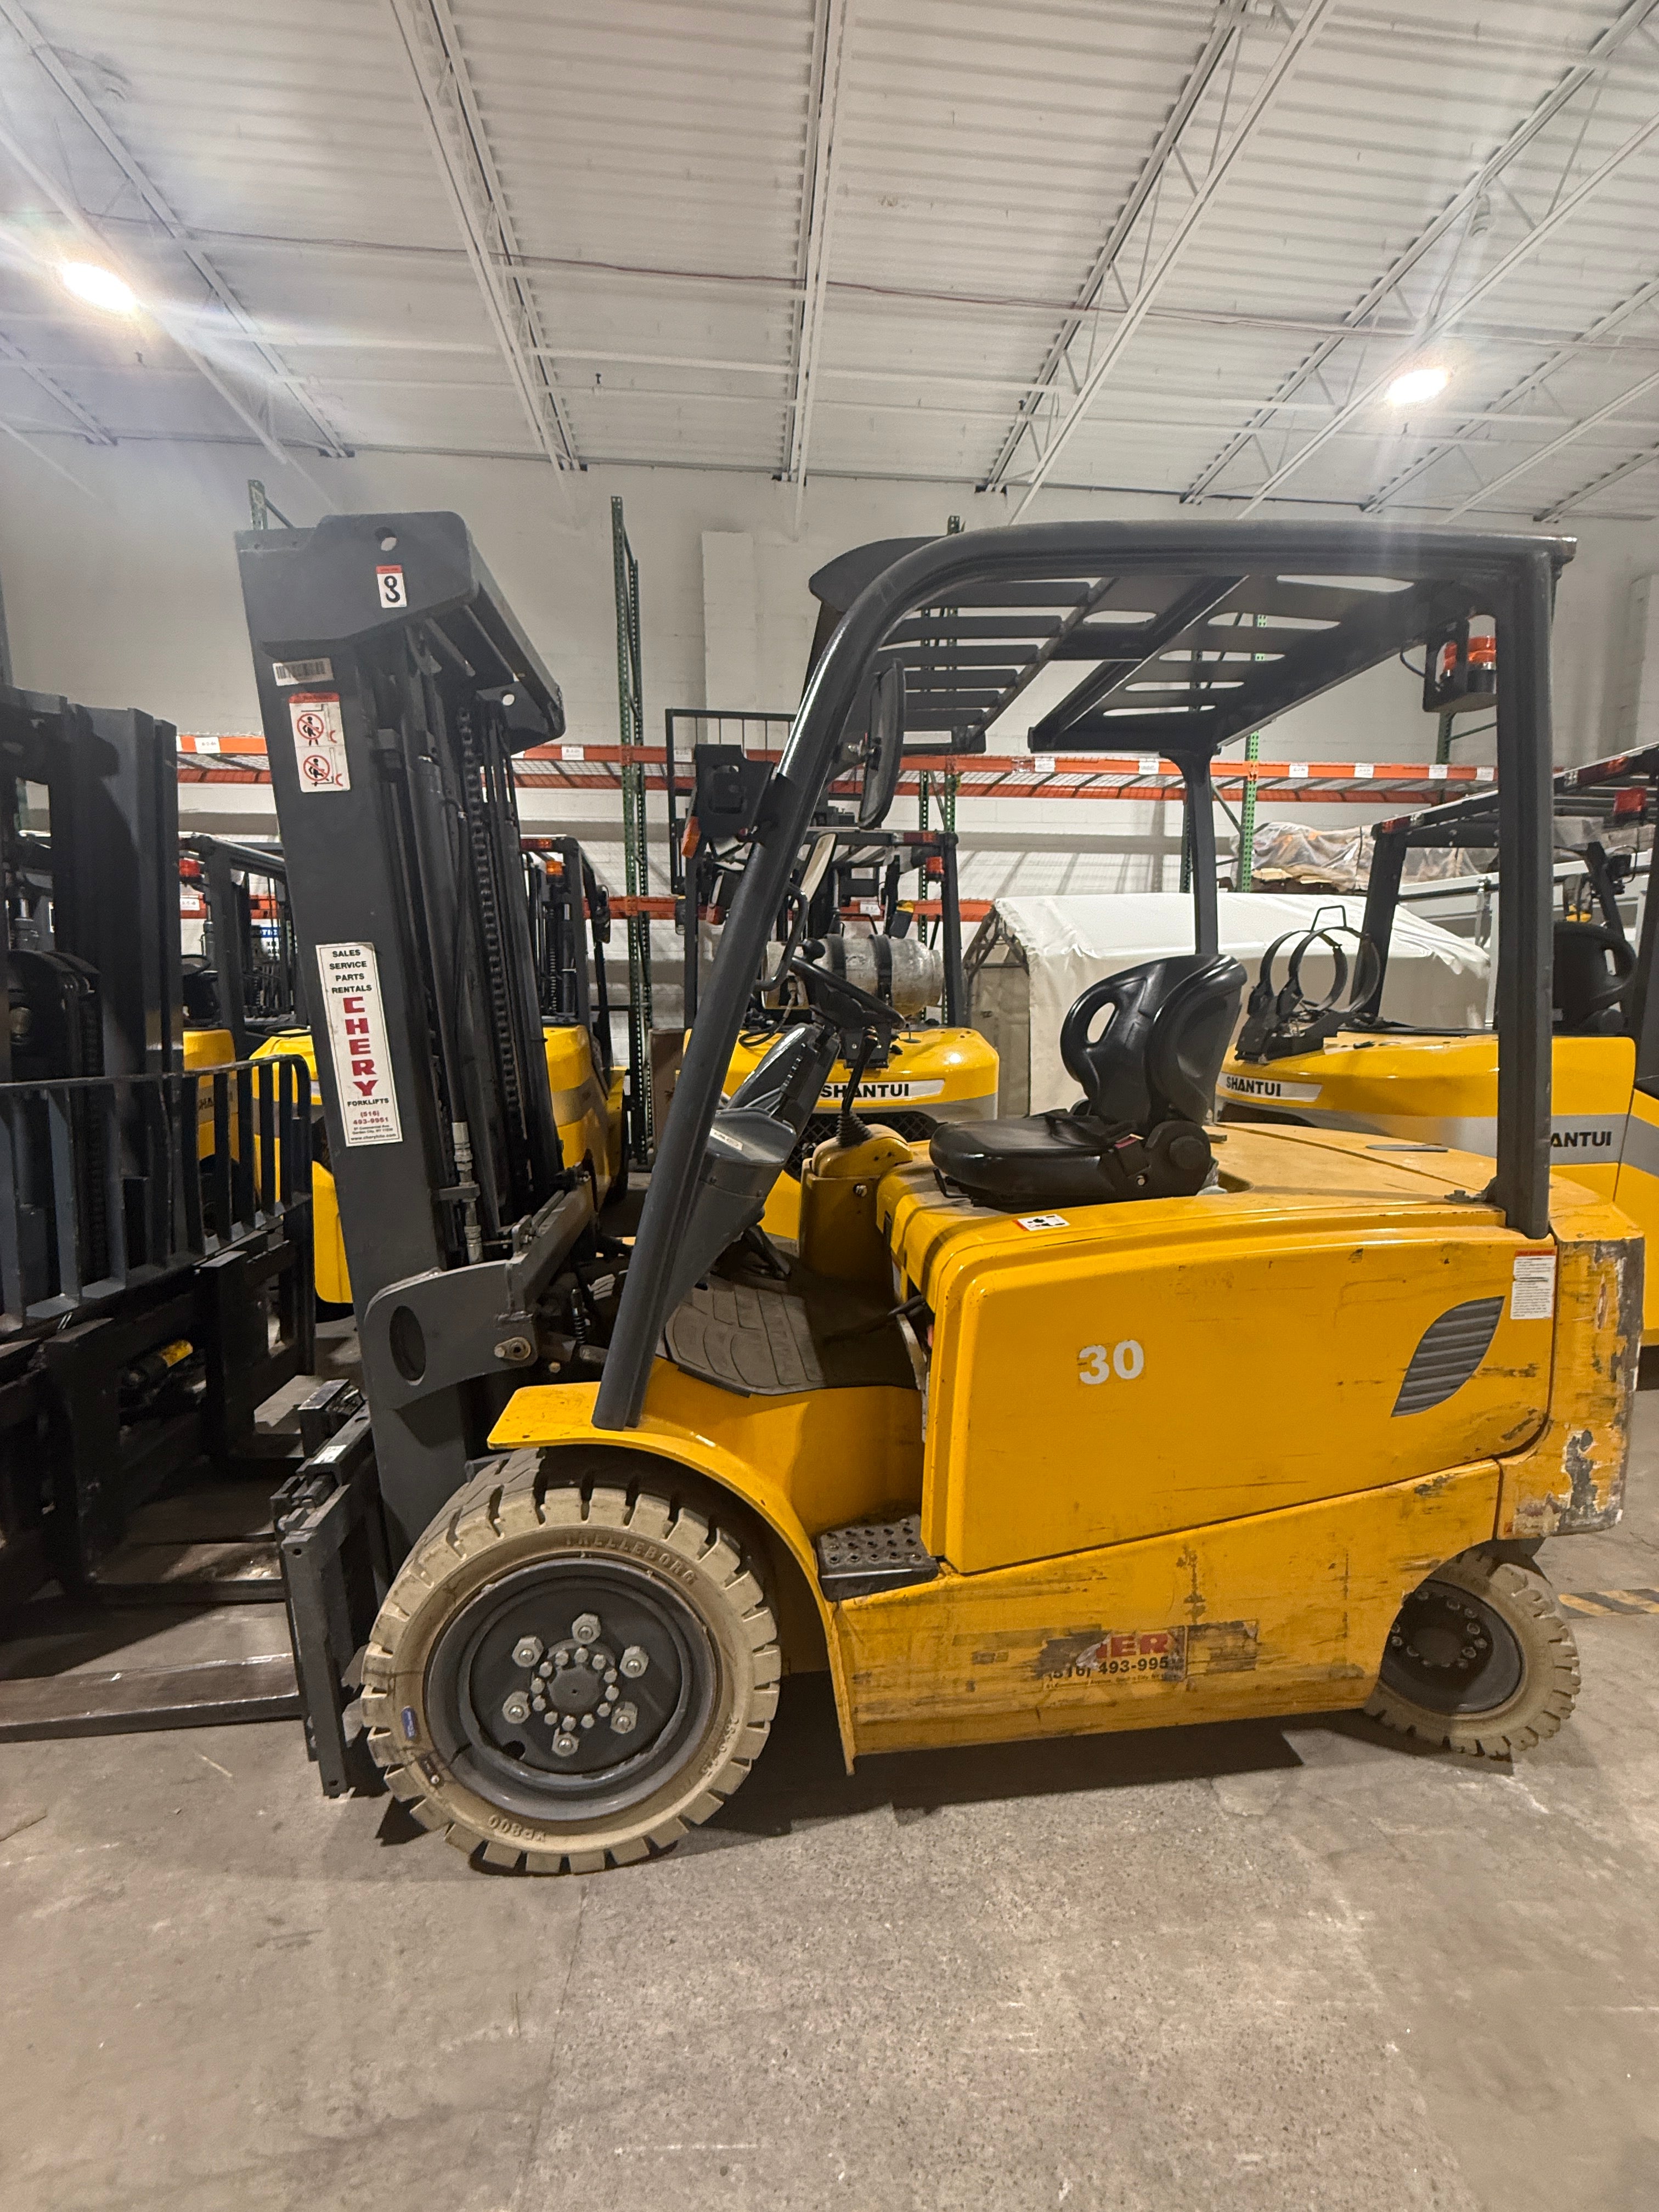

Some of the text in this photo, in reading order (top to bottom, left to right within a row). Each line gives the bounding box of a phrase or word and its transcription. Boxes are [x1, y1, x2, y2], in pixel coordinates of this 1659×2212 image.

[332, 949, 361, 958] SALES
[329, 961, 367, 970] SERVICE
[335, 973, 365, 981] PARTS
[331, 985, 372, 994] RENTALS
[342, 996, 379, 1097] CHERY
[820, 1084, 909, 1098] SHANTUI
[1226, 1076, 1281, 1097] SHANTUI
[347, 1097, 390, 1107] FORKLIFTS
[1550, 1131, 1612, 1147] ANTUI
[1077, 1339, 1145, 1385] 30
